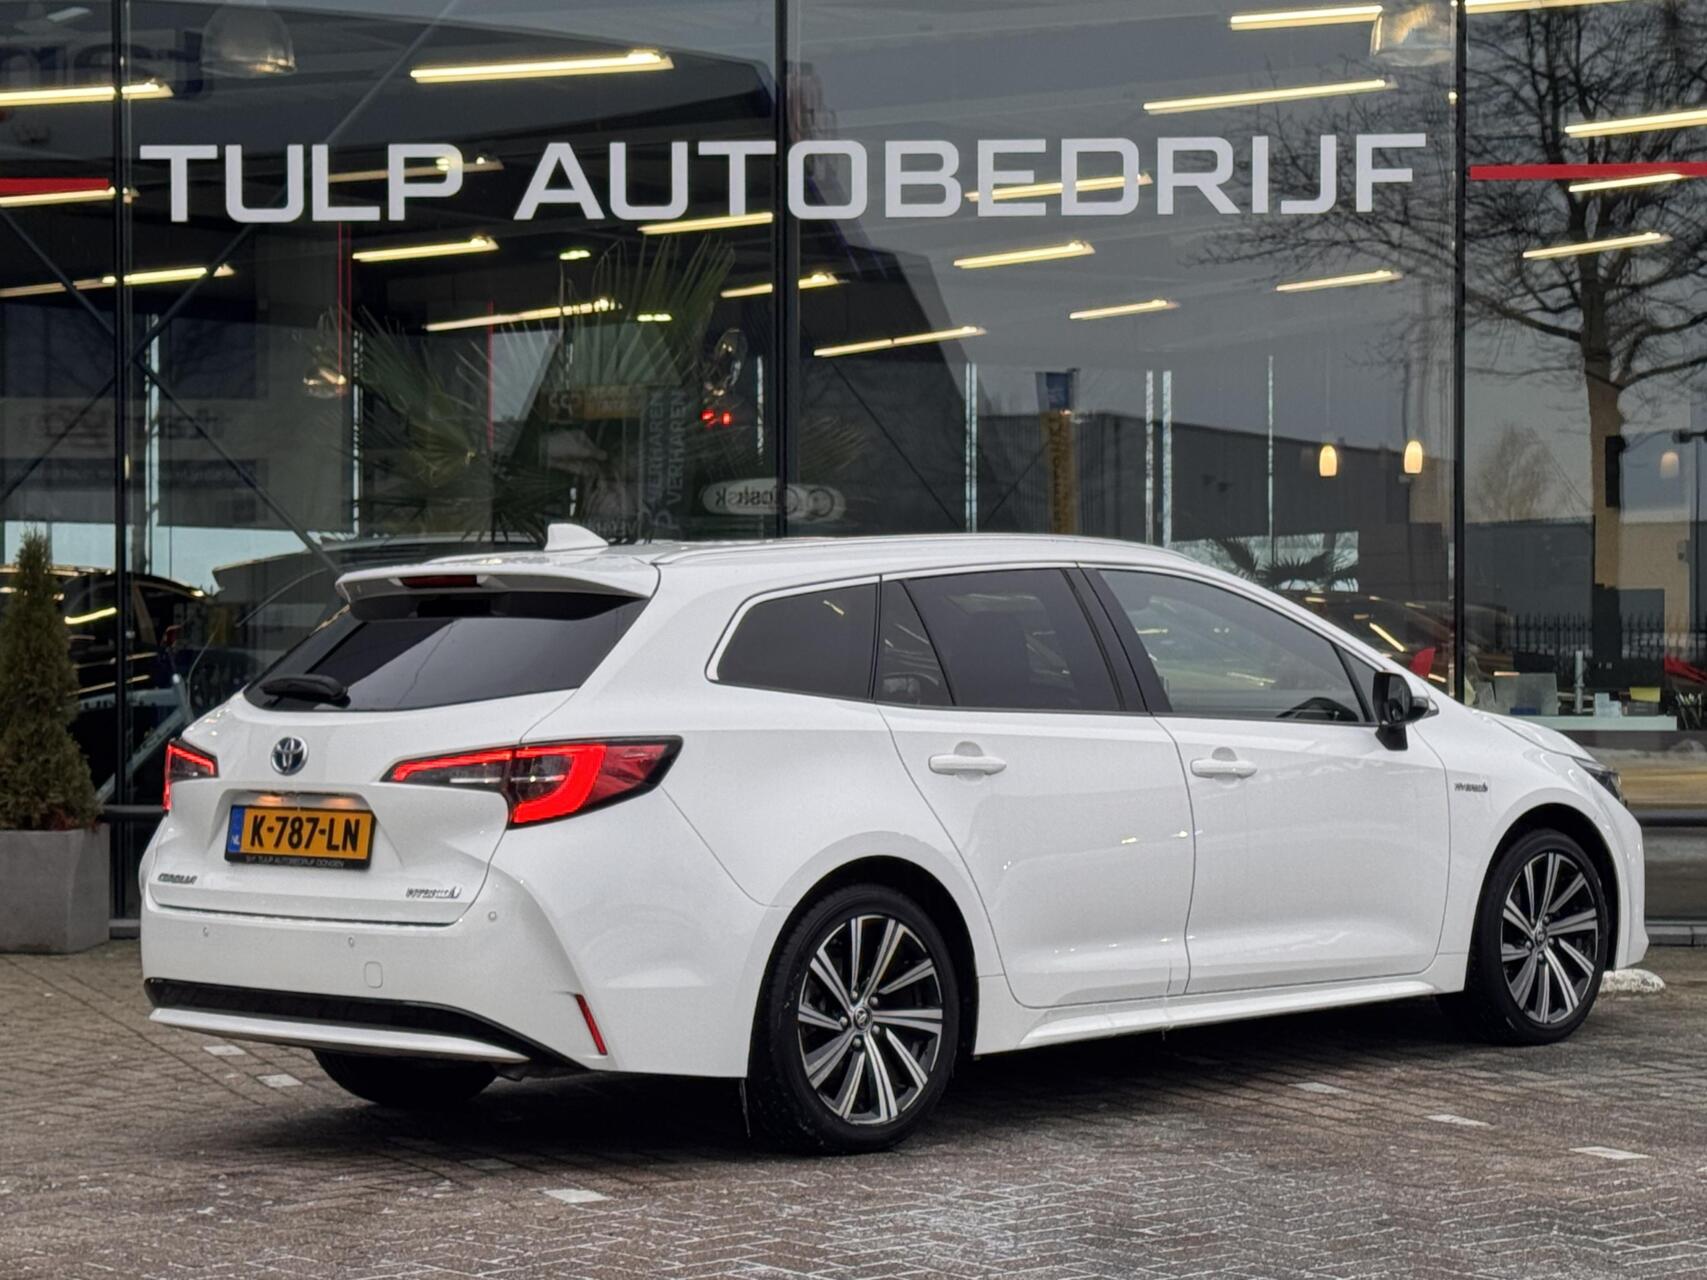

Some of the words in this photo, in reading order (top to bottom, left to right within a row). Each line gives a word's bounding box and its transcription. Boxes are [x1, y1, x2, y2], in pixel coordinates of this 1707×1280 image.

[139, 143, 465, 223] TULP
[514, 133, 1427, 222] AUTOBEDRIJF
[250, 815, 361, 853] K-787-LN
